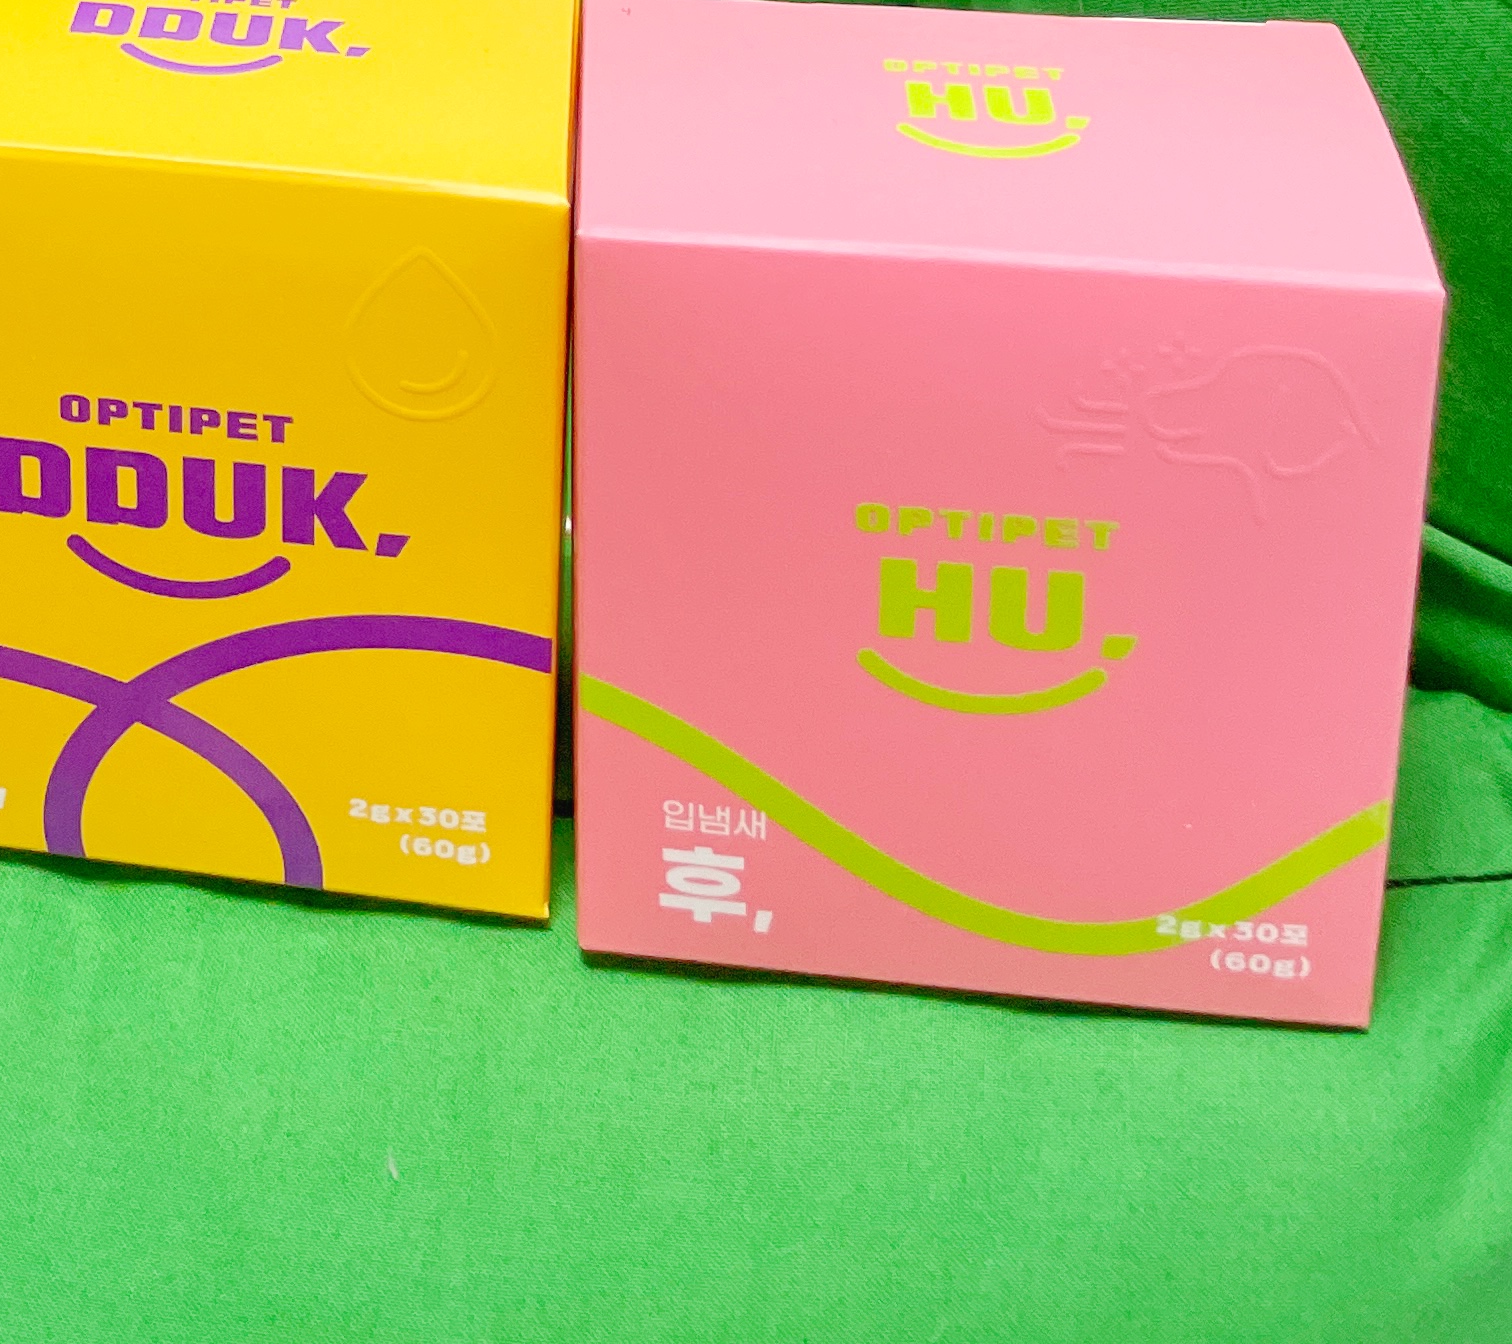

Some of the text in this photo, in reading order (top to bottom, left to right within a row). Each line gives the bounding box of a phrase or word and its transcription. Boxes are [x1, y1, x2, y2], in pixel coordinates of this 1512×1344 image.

[883, 58, 1065, 81] OPTIPET
[60, 394, 294, 443] OPTIPET
[855, 502, 1120, 551] OPTIPET
[662, 799, 767, 841] 입냄새
[399, 833, 491, 866] (60g)
[1210, 948, 1311, 980] (60g)
